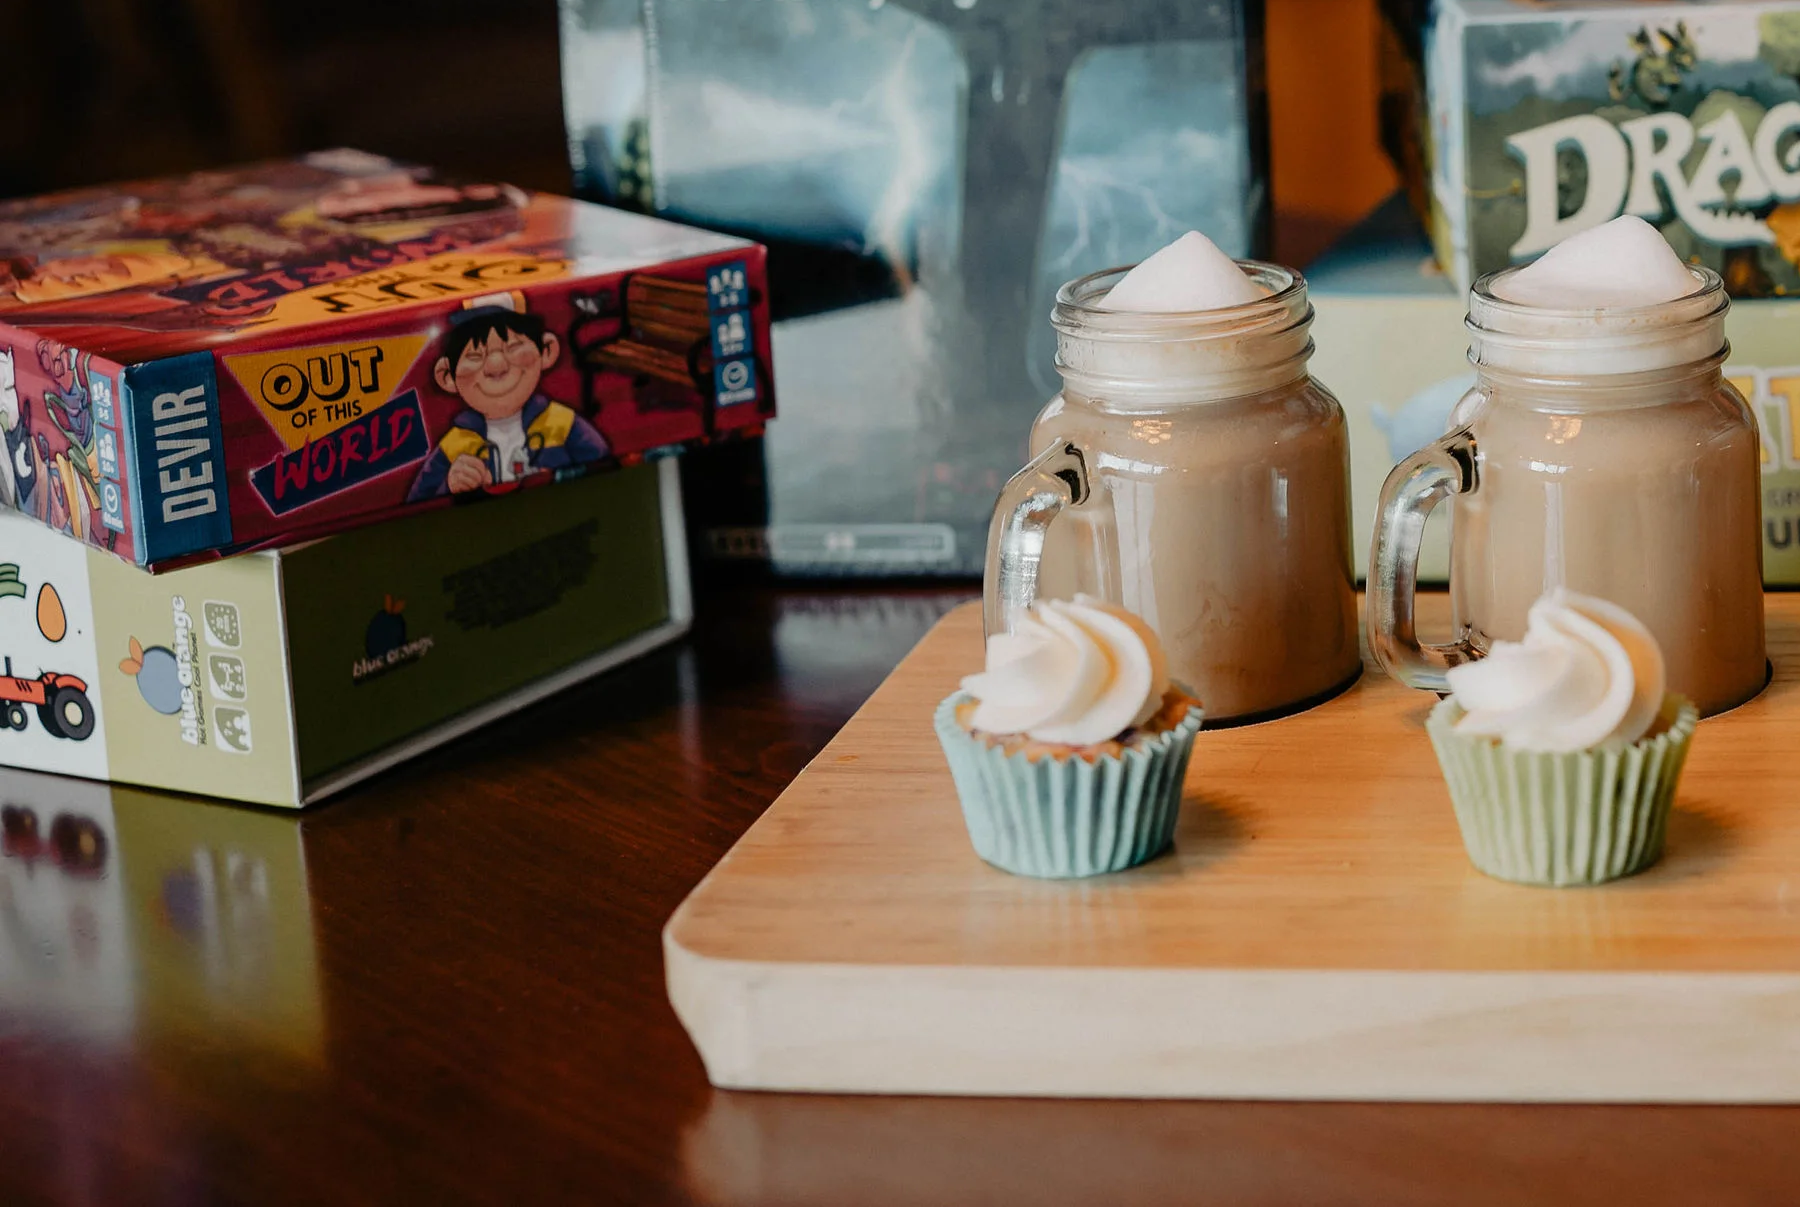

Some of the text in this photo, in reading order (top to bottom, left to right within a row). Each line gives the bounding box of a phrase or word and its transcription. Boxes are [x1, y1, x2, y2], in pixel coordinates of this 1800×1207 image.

[261, 346, 384, 411] OUT
[291, 399, 363, 429] OF THIS
[152, 384, 218, 523] DEVIR
[274, 406, 416, 500] WORLD
[172, 595, 199, 747] blue orange
